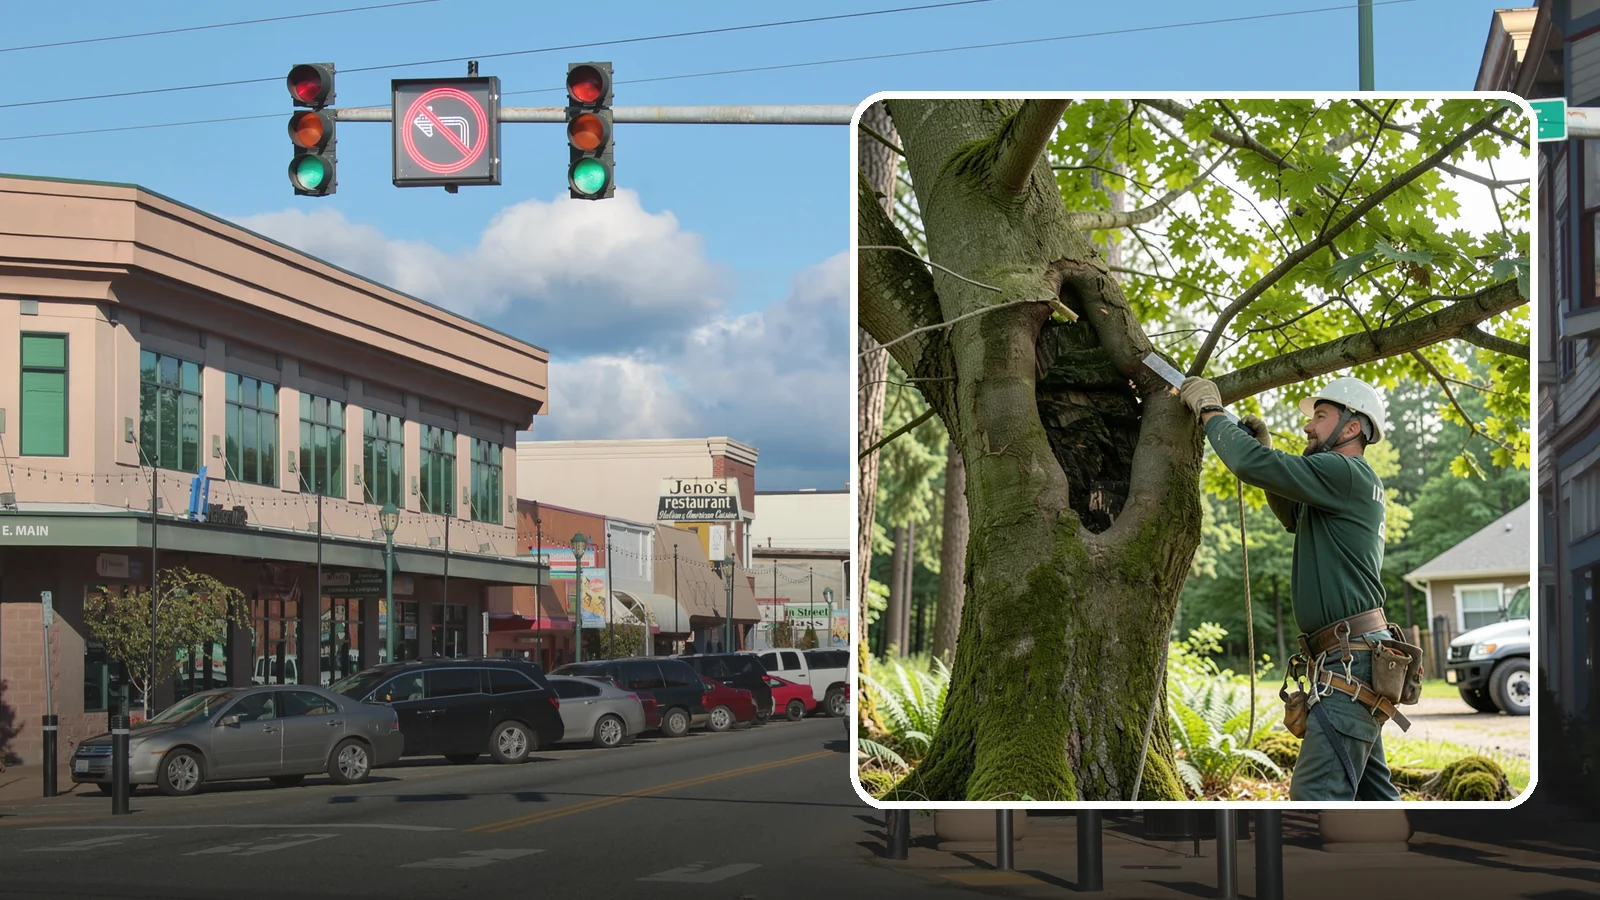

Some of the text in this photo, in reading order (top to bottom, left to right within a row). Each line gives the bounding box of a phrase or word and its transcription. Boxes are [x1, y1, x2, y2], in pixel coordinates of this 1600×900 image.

[669, 480, 727, 495] Jeno's
[664, 496, 731, 509] restaurant
[658, 509, 682, 519] Italian
[686, 509, 714, 519] American
[714, 509, 738, 519] Cuisine
[2, 525, 49, 536] E. MAIN
[797, 607, 828, 617] Street
